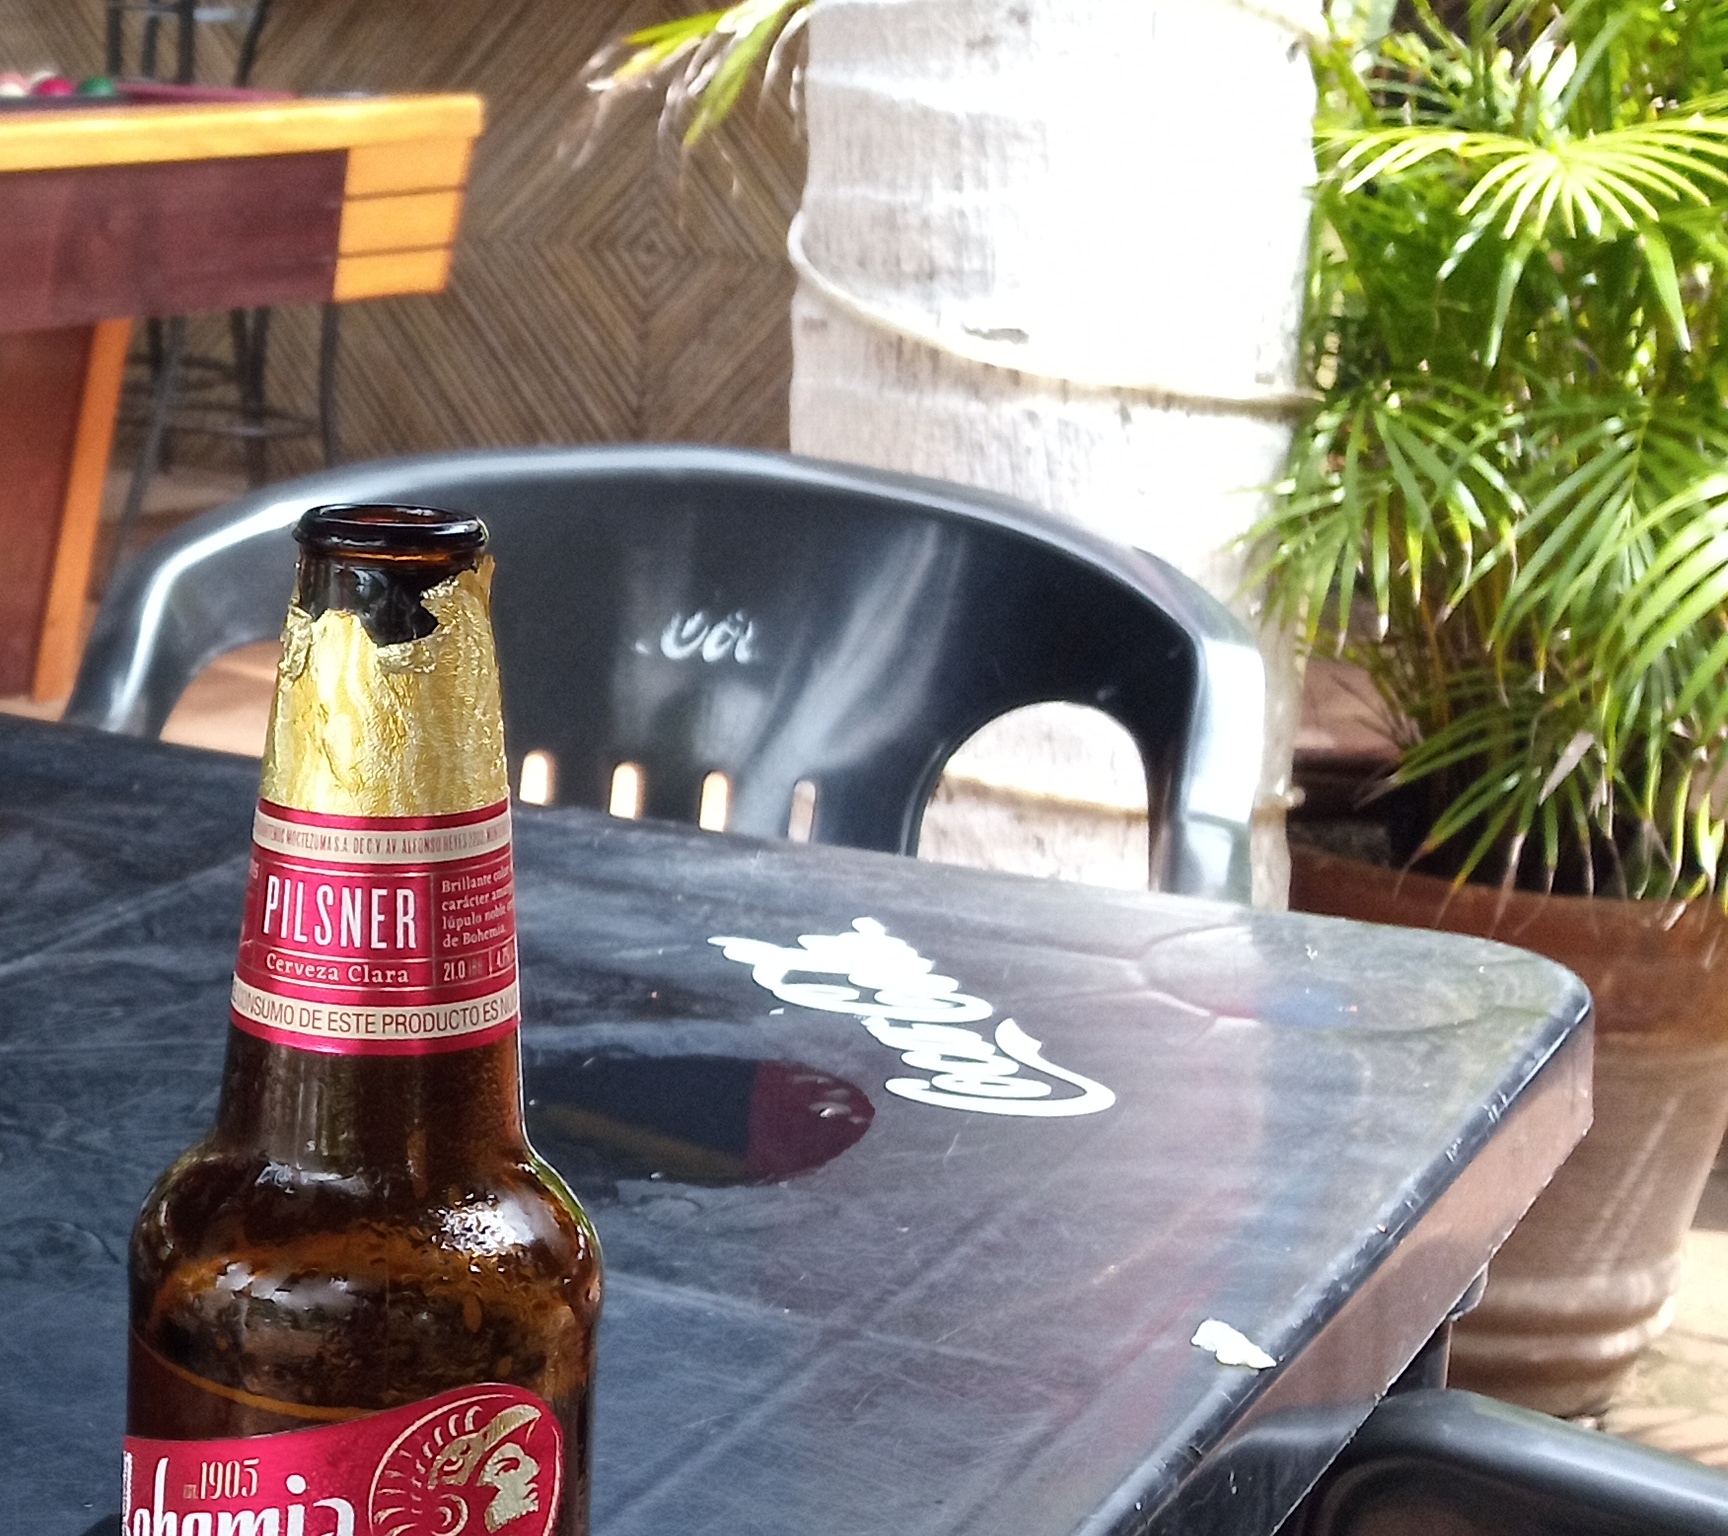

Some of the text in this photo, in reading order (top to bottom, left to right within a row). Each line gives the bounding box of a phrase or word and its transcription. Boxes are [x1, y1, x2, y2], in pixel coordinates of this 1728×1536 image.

[441, 874, 492, 893] Brillante
[263, 875, 417, 949] PILSNER
[441, 892, 490, 912] carácter
[442, 912, 482, 932] lúpulo
[443, 934, 459, 948] de
[266, 953, 410, 984] Cerveza Clara
[443, 959, 466, 982] 21.0
[298, 1007, 322, 1031] DE
[327, 1013, 377, 1034] ESTE
[382, 1005, 480, 1034] PRODUCTO
[483, 999, 499, 1023] ES
[200, 1458, 260, 1499] 1905
